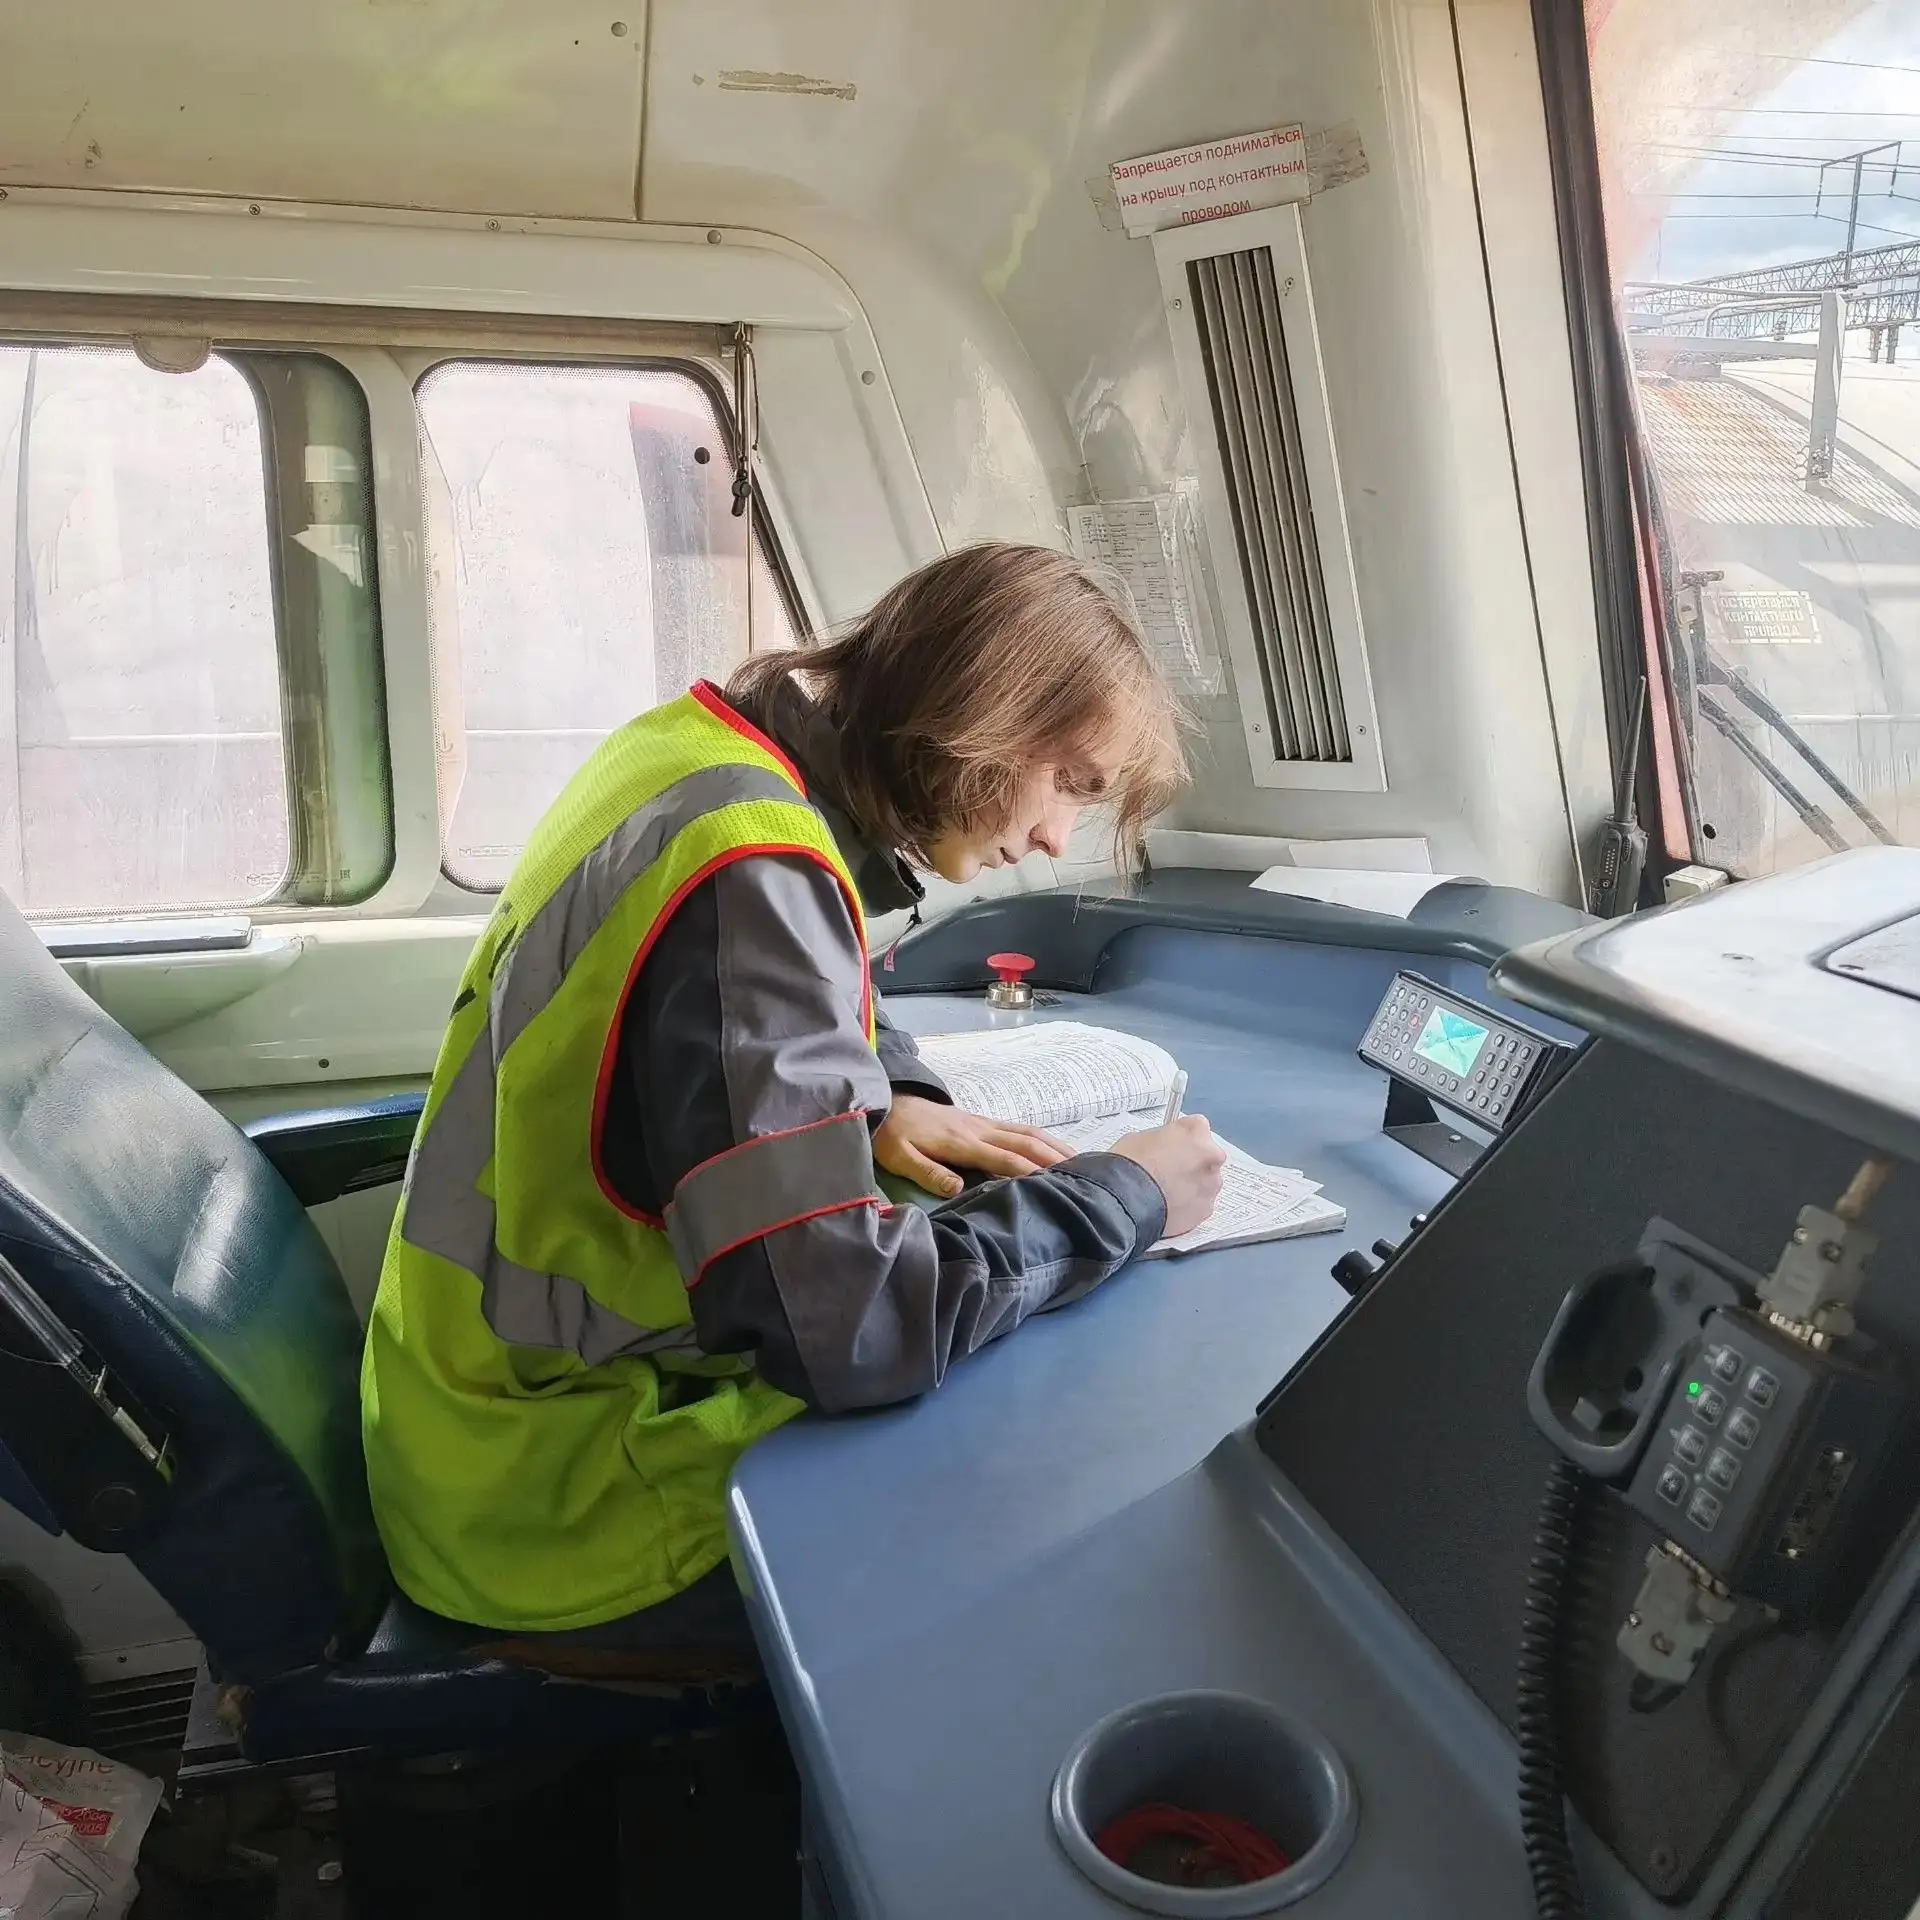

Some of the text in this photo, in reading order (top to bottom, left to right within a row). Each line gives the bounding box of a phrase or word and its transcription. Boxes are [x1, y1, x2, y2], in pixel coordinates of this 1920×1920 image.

[1113, 130, 1301, 180] Запрещается подниматься
[1122, 158, 1305, 207] на крышу под контактным
[1181, 199, 1251, 224] проводом
